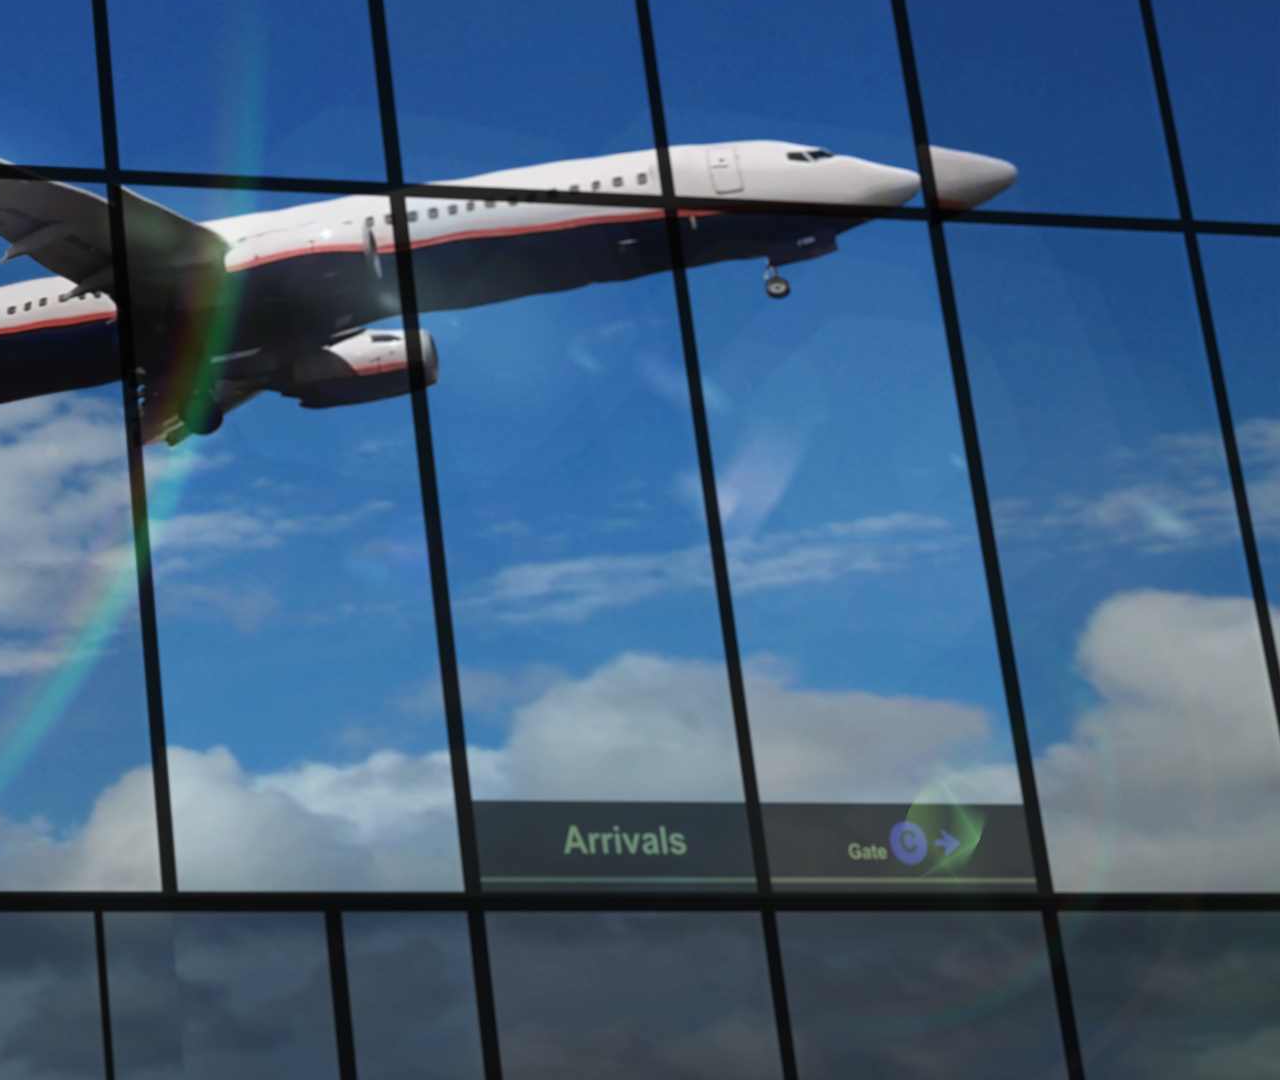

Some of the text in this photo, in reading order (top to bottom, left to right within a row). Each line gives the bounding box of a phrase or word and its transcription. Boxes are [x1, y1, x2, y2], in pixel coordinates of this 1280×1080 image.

[563, 825, 687, 856] Arrivals
[848, 830, 917, 861] Gate C
